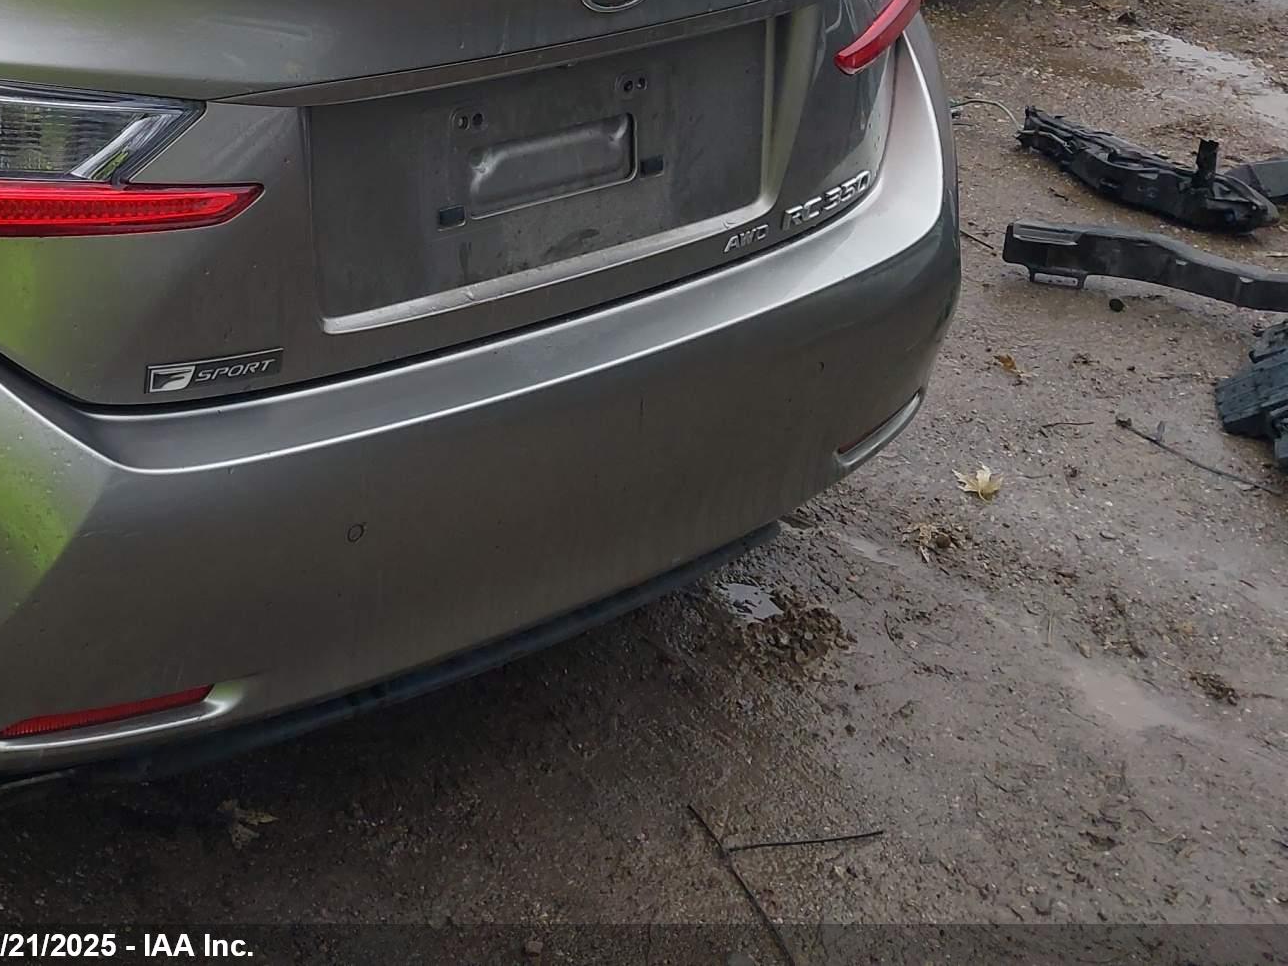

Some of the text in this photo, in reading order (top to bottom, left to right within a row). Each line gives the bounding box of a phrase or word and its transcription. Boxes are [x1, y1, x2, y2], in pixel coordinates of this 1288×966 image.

[781, 170, 872, 231] RC 350
[723, 224, 769, 253] AWD
[194, 358, 276, 382] SPORT
